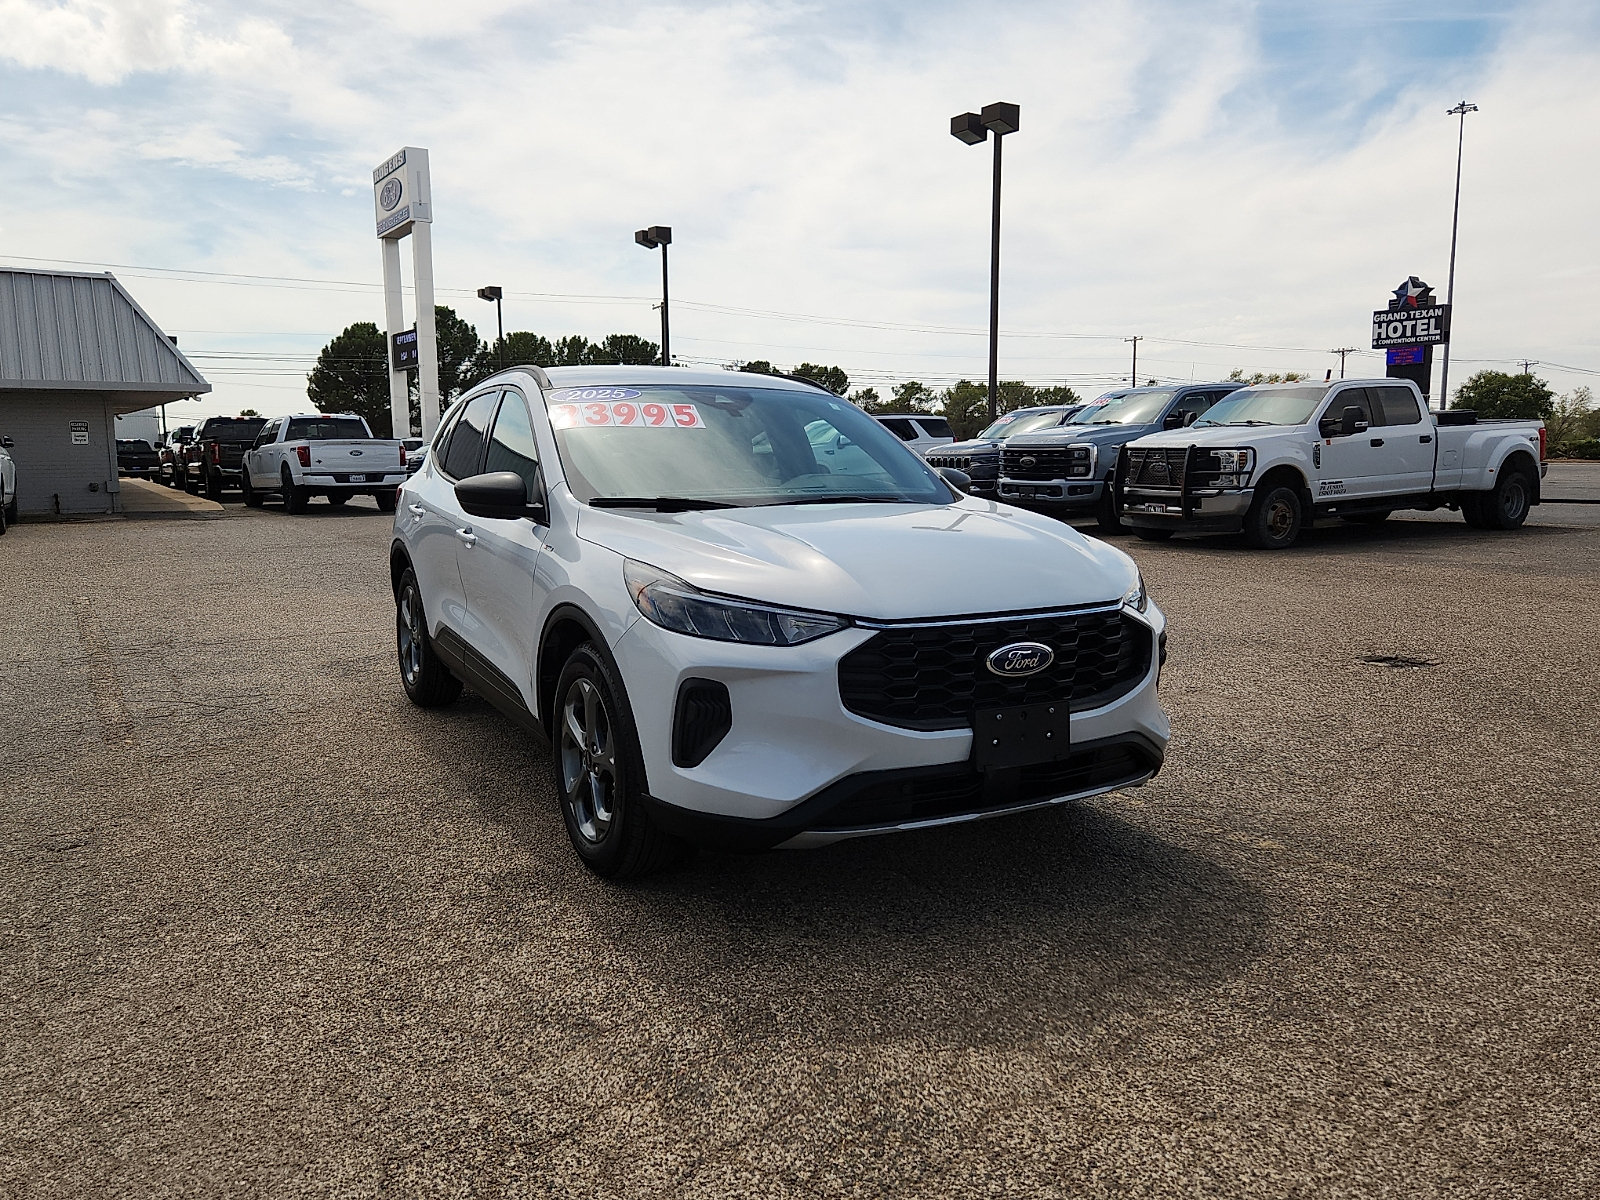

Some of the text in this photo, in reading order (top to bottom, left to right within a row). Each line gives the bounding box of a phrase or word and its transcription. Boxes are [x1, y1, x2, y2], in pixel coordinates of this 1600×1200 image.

[374, 151, 405, 182] ROGERS
[1373, 308, 1443, 322] GRAND TEXAN
[1372, 318, 1440, 339] HOTEL
[1378, 336, 1416, 345] CONVENTION
[567, 388, 626, 401] 2025
[1004, 649, 1041, 670] Ford
